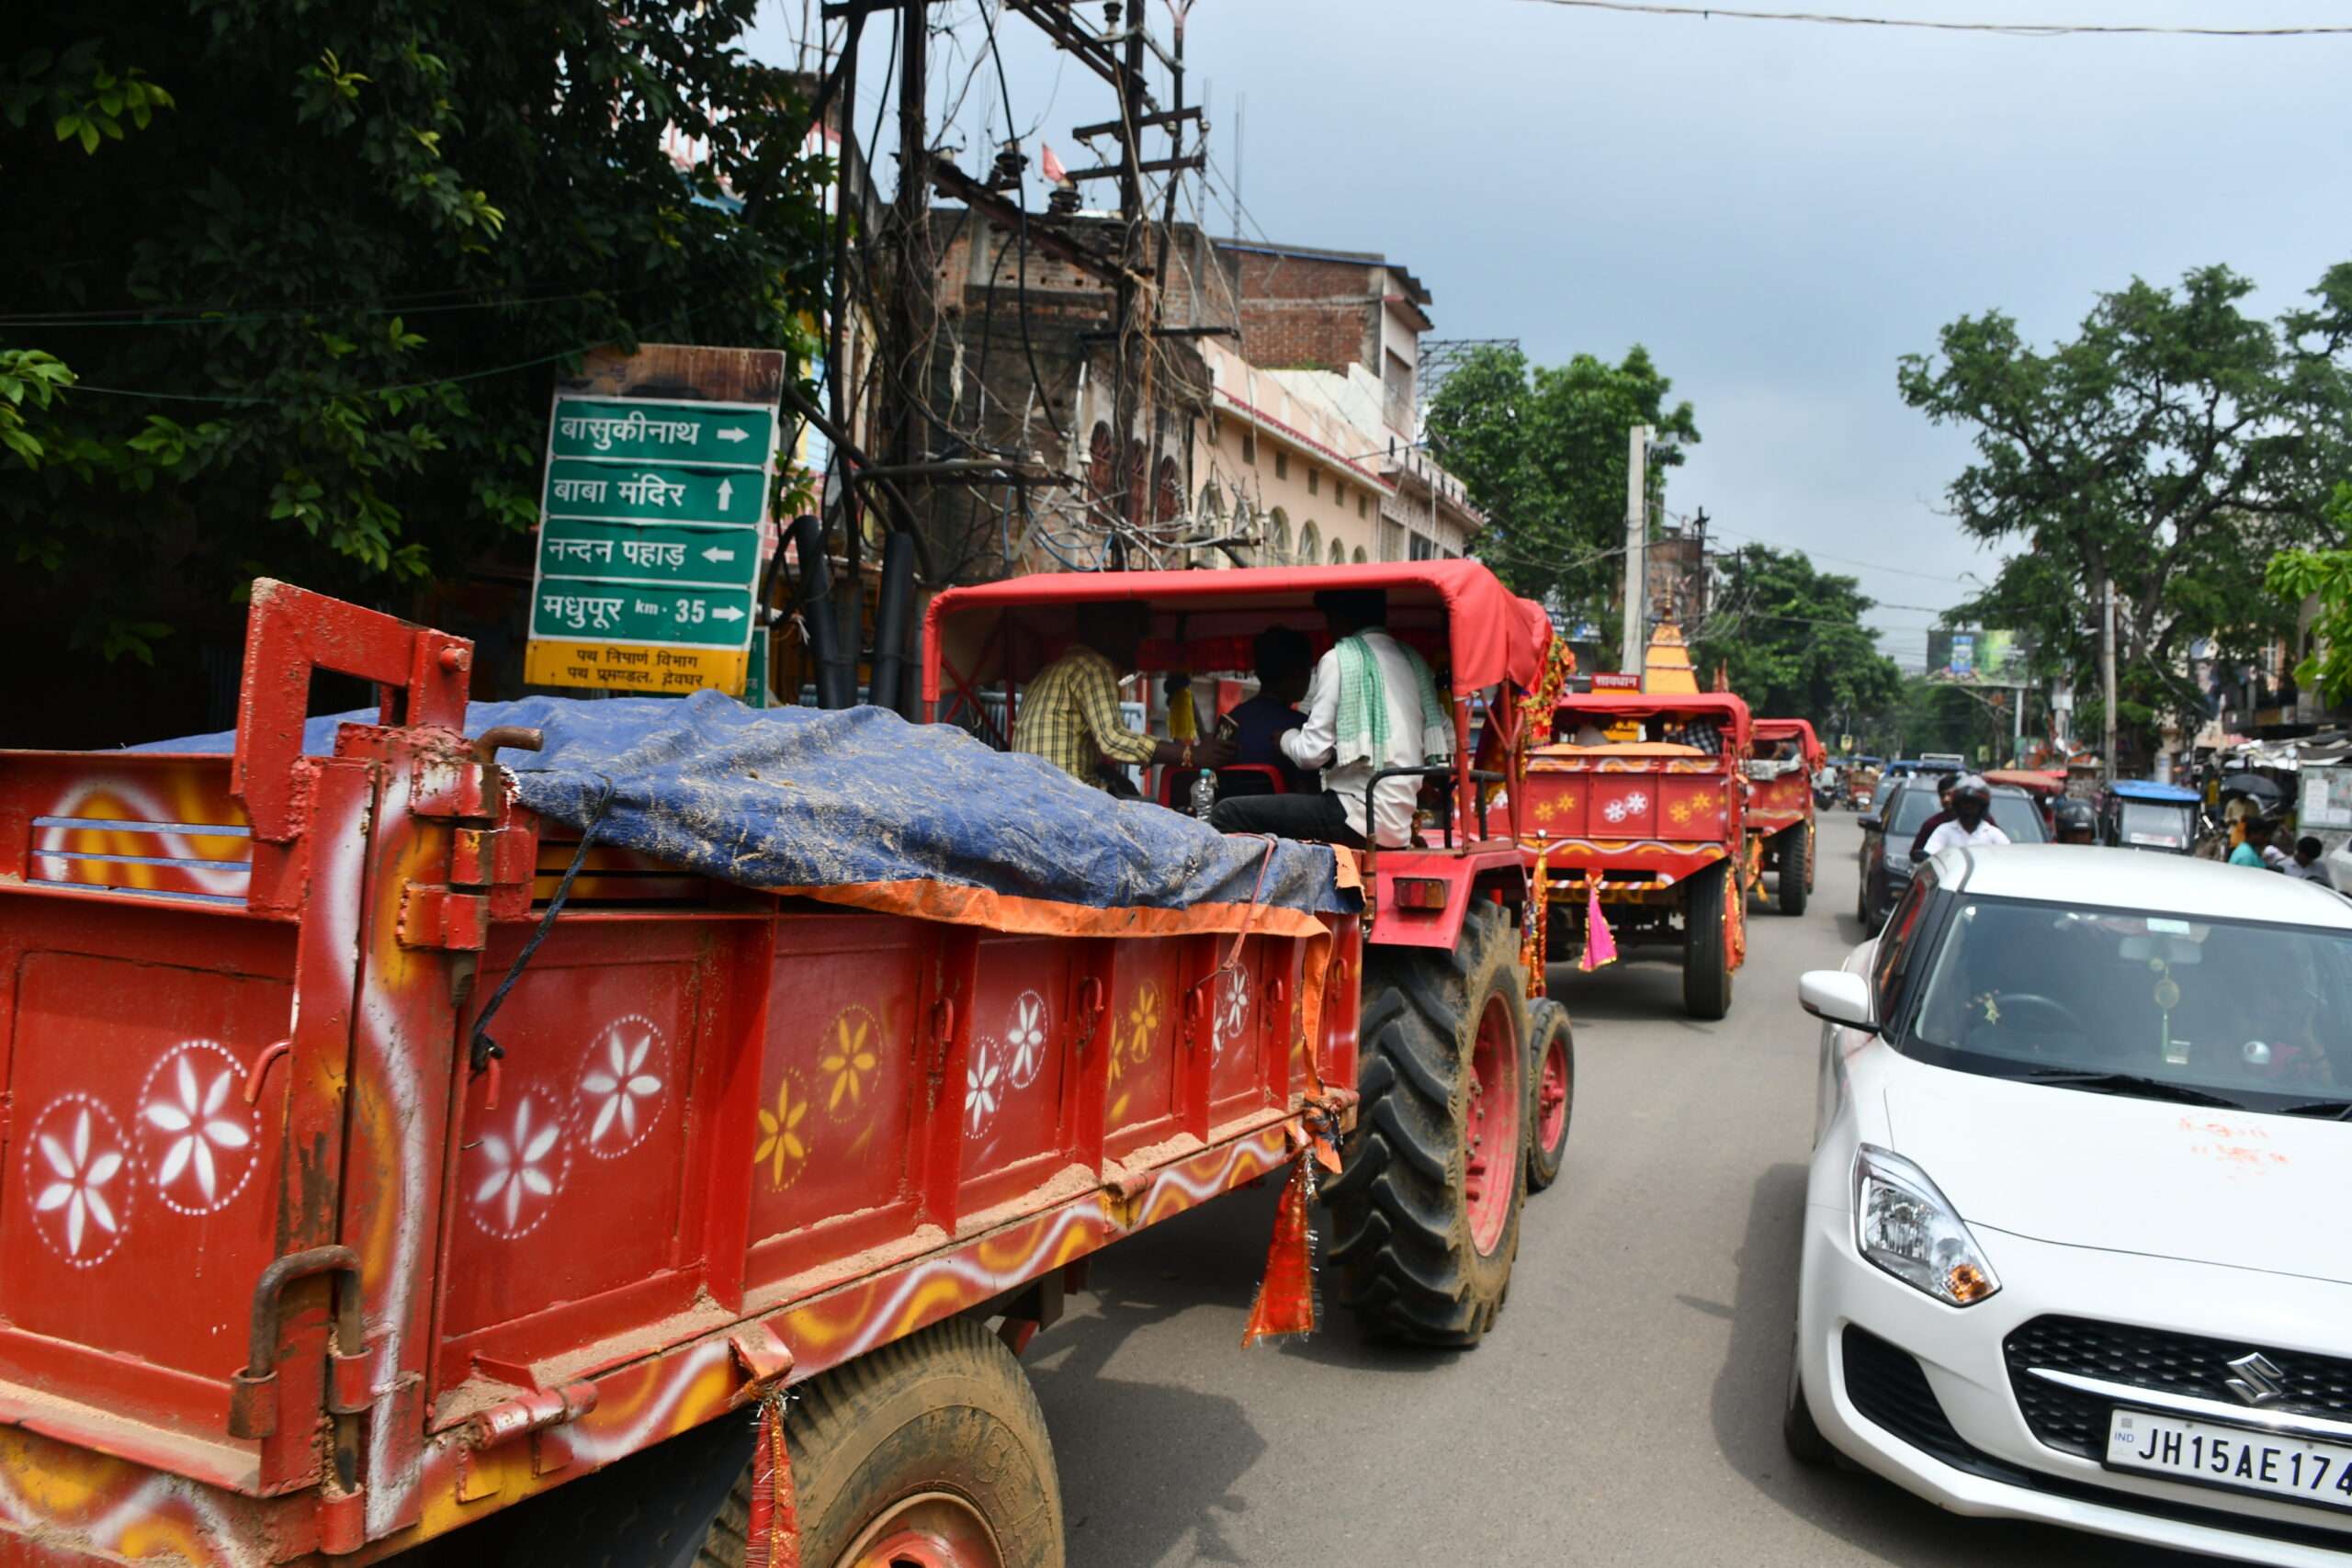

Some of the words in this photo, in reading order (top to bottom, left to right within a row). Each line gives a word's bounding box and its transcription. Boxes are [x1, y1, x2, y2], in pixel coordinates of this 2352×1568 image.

[560, 411, 701, 450] बासुकीनाथ
[553, 479, 608, 502] बाबा
[617, 472, 686, 506] मंदिर
[547, 538, 615, 563] नन्दन
[622, 540, 687, 571] पहाड़
[542, 595, 625, 629] मधुपूर
[675, 598, 707, 624] 35
[576, 649, 598, 662] पथ
[656, 650, 698, 668] विभाग
[567, 666, 589, 679] पथ
[662, 669, 704, 686] देवघर
[2114, 1431, 2135, 1443] IND
[2138, 1428, 2352, 1495] JH15AE174
